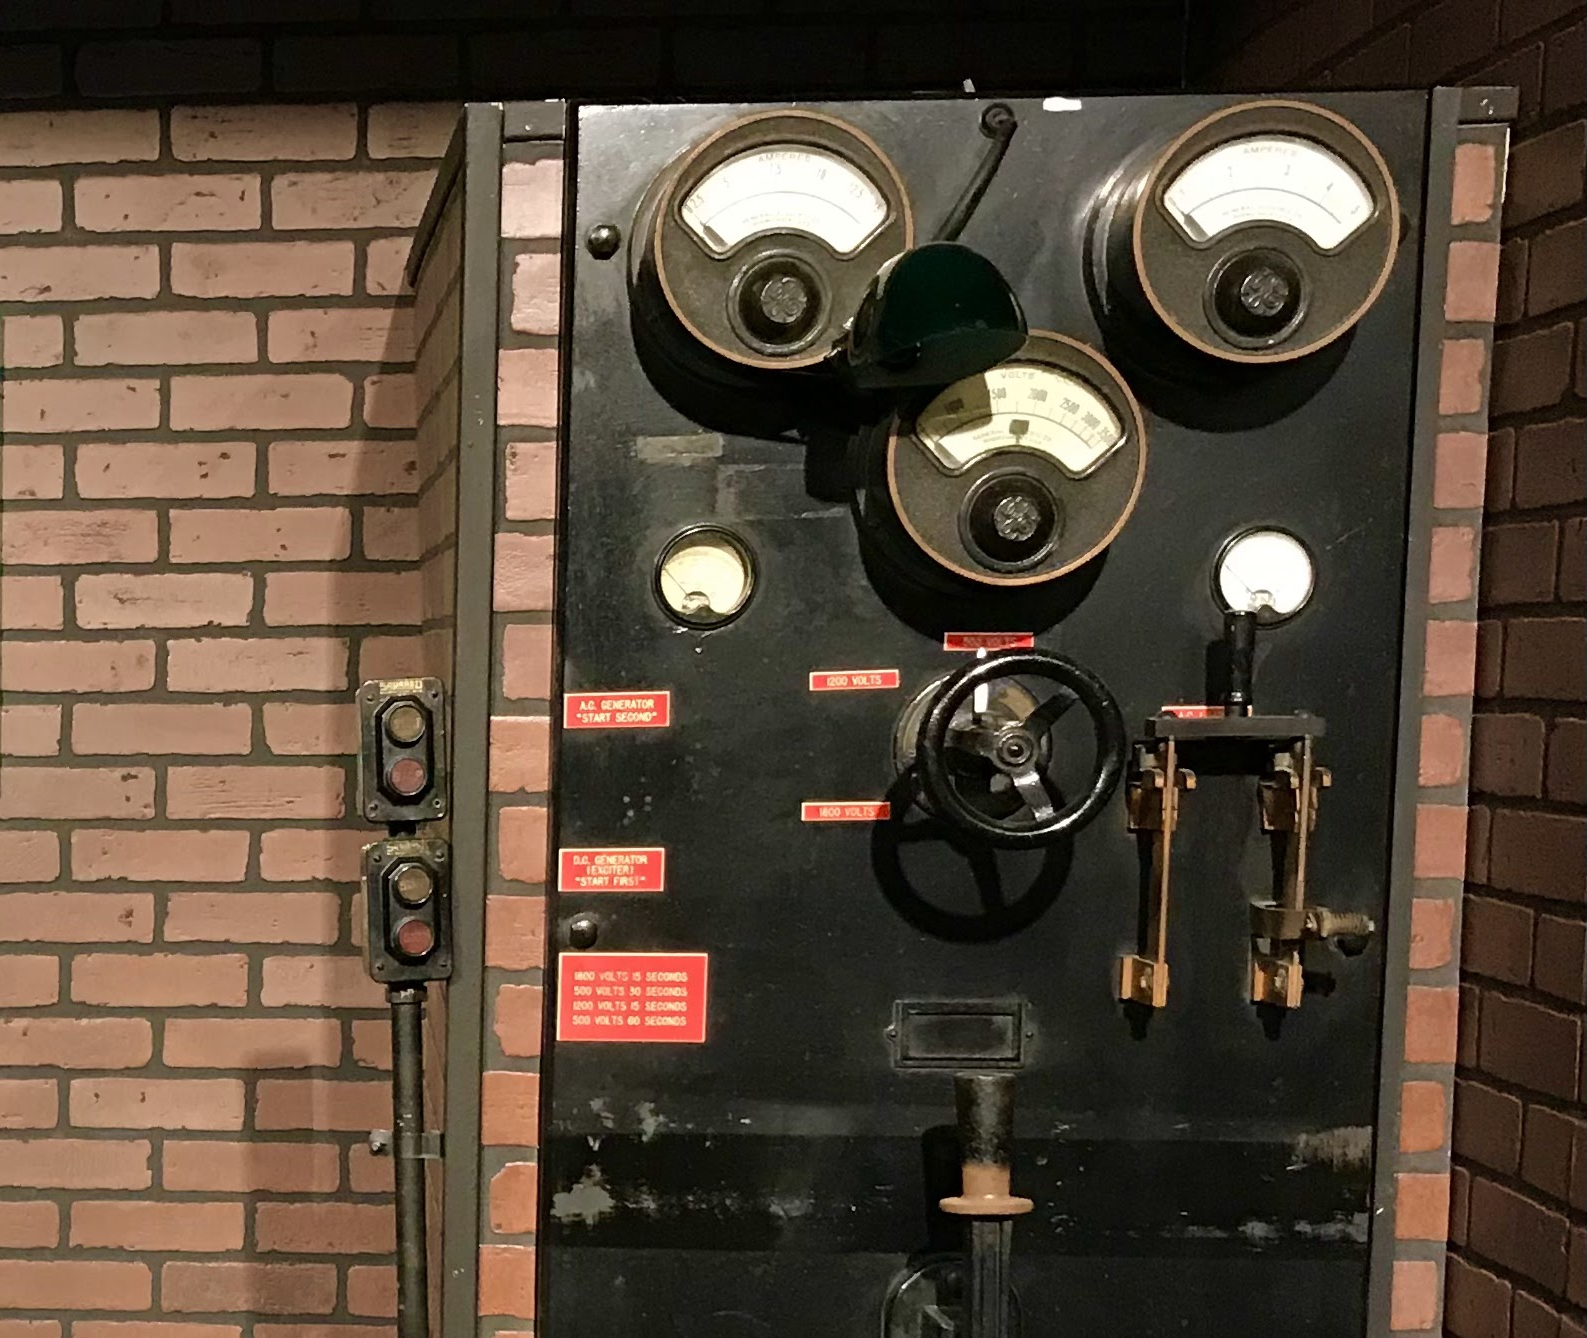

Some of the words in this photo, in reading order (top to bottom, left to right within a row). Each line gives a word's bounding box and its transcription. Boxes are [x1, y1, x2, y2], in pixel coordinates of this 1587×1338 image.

[1000, 371, 1035, 379] VOLTS
[826, 677, 848, 687] 1200
[851, 675, 882, 685] VOLTS
[579, 701, 596, 711] A.C.
[600, 699, 654, 710] GENERATOR
[844, 807, 875, 817] VOLTS
[594, 855, 648, 865] GENERATOR
[599, 971, 629, 982] VOLTS
[645, 971, 688, 983] SECONDS
[573, 985, 592, 996] 500
[595, 986, 625, 997] VOLTS
[645, 986, 688, 997] SECONDS
[597, 1001, 627, 1012] VOLTS
[644, 1001, 687, 1012] SECONDS
[594, 1015, 624, 1026] VOLTS
[644, 1016, 687, 1026] SECONDS
